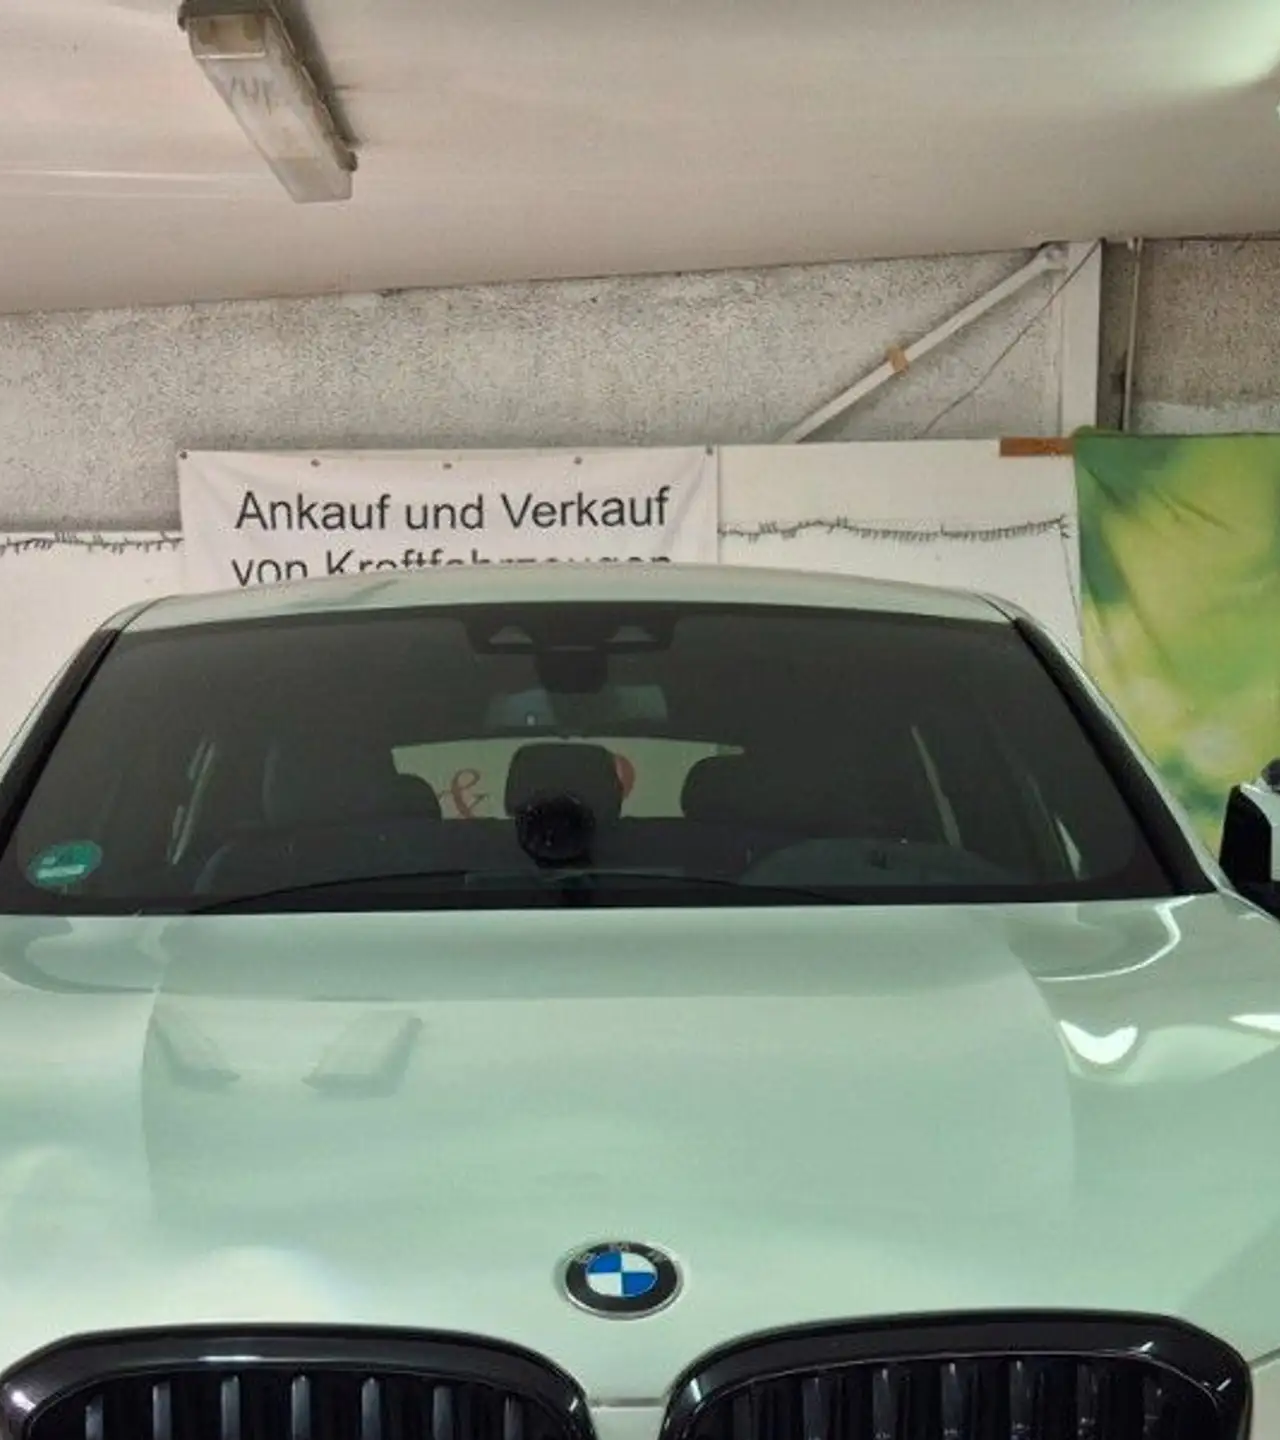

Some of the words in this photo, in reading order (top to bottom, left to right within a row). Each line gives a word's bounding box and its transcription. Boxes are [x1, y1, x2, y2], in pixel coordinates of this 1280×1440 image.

[235, 490, 392, 531] Ankauf
[405, 494, 484, 530] und
[500, 484, 671, 529] Verkauf
[231, 558, 308, 587] von
